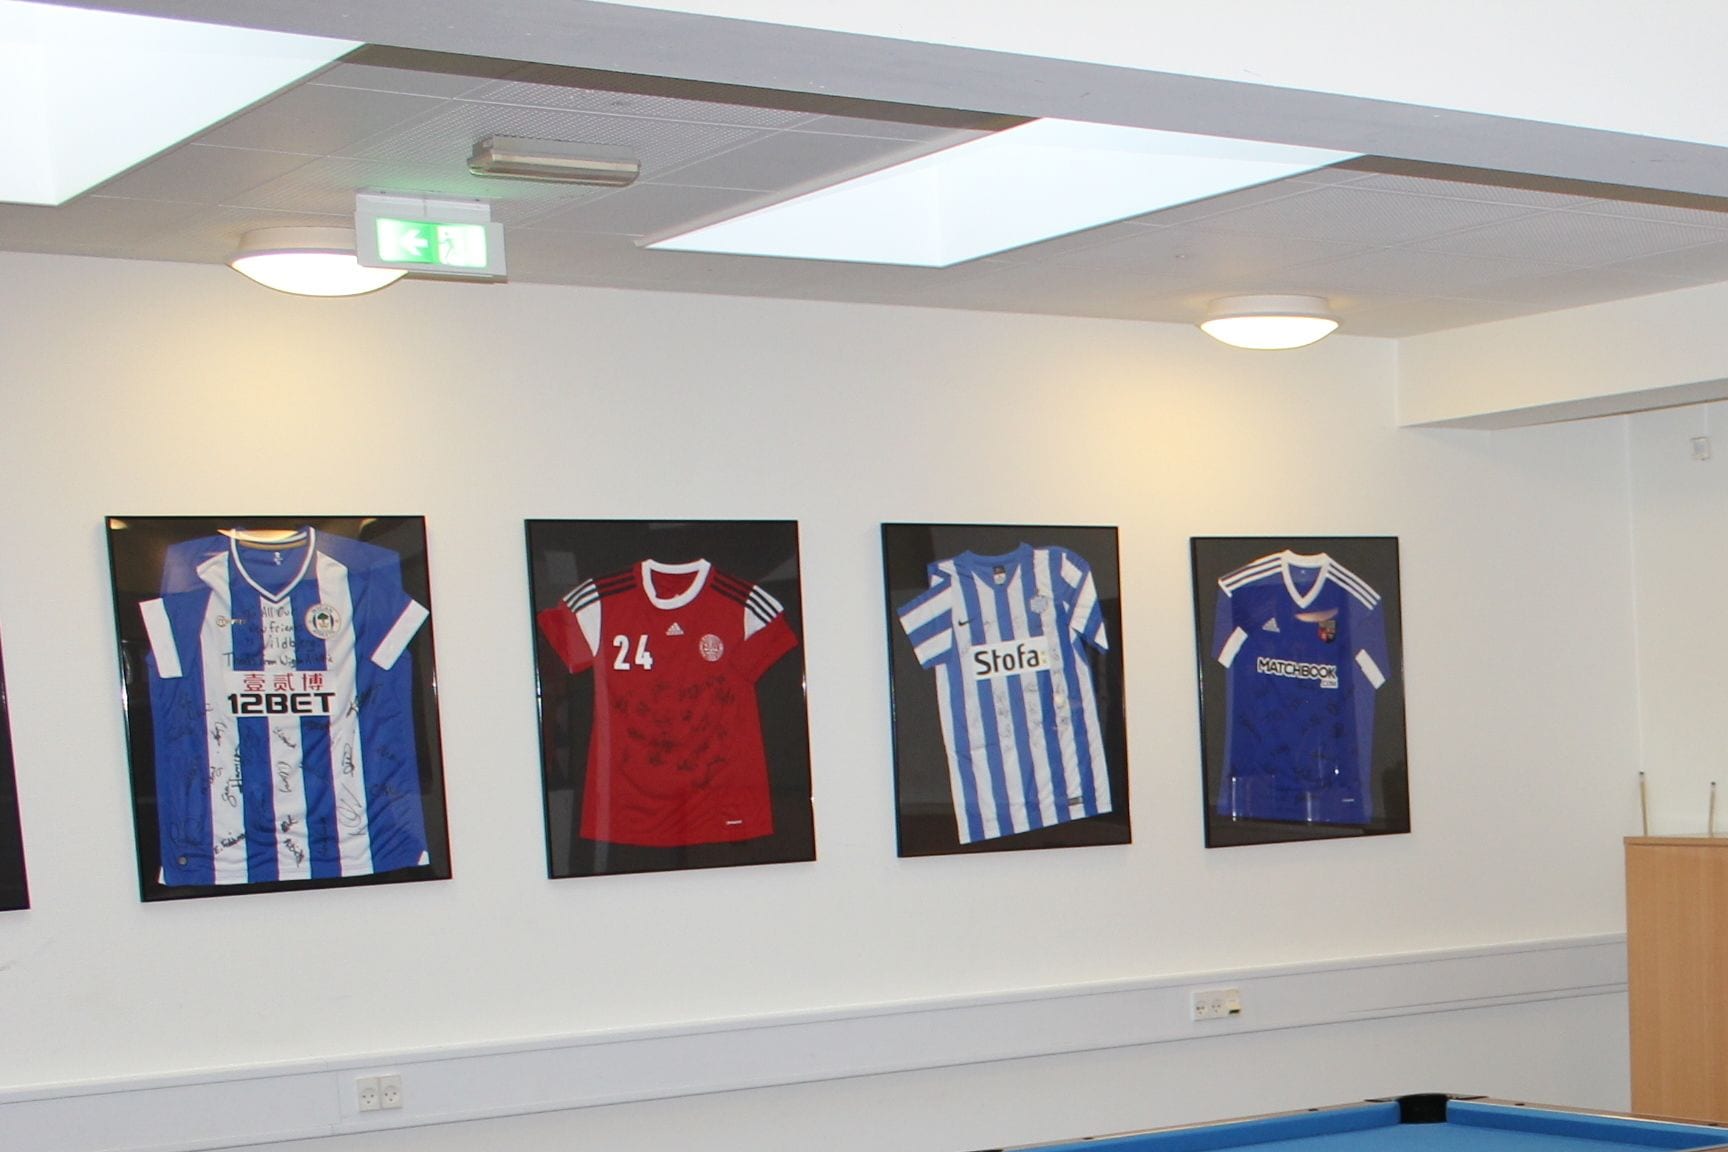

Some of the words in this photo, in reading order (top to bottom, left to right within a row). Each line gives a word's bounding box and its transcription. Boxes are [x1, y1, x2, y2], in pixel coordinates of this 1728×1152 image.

[612, 634, 653, 670] 24
[974, 643, 1040, 676] Stofa
[1257, 656, 1337, 680] MATCHBOOK
[227, 692, 336, 715] 12BET
